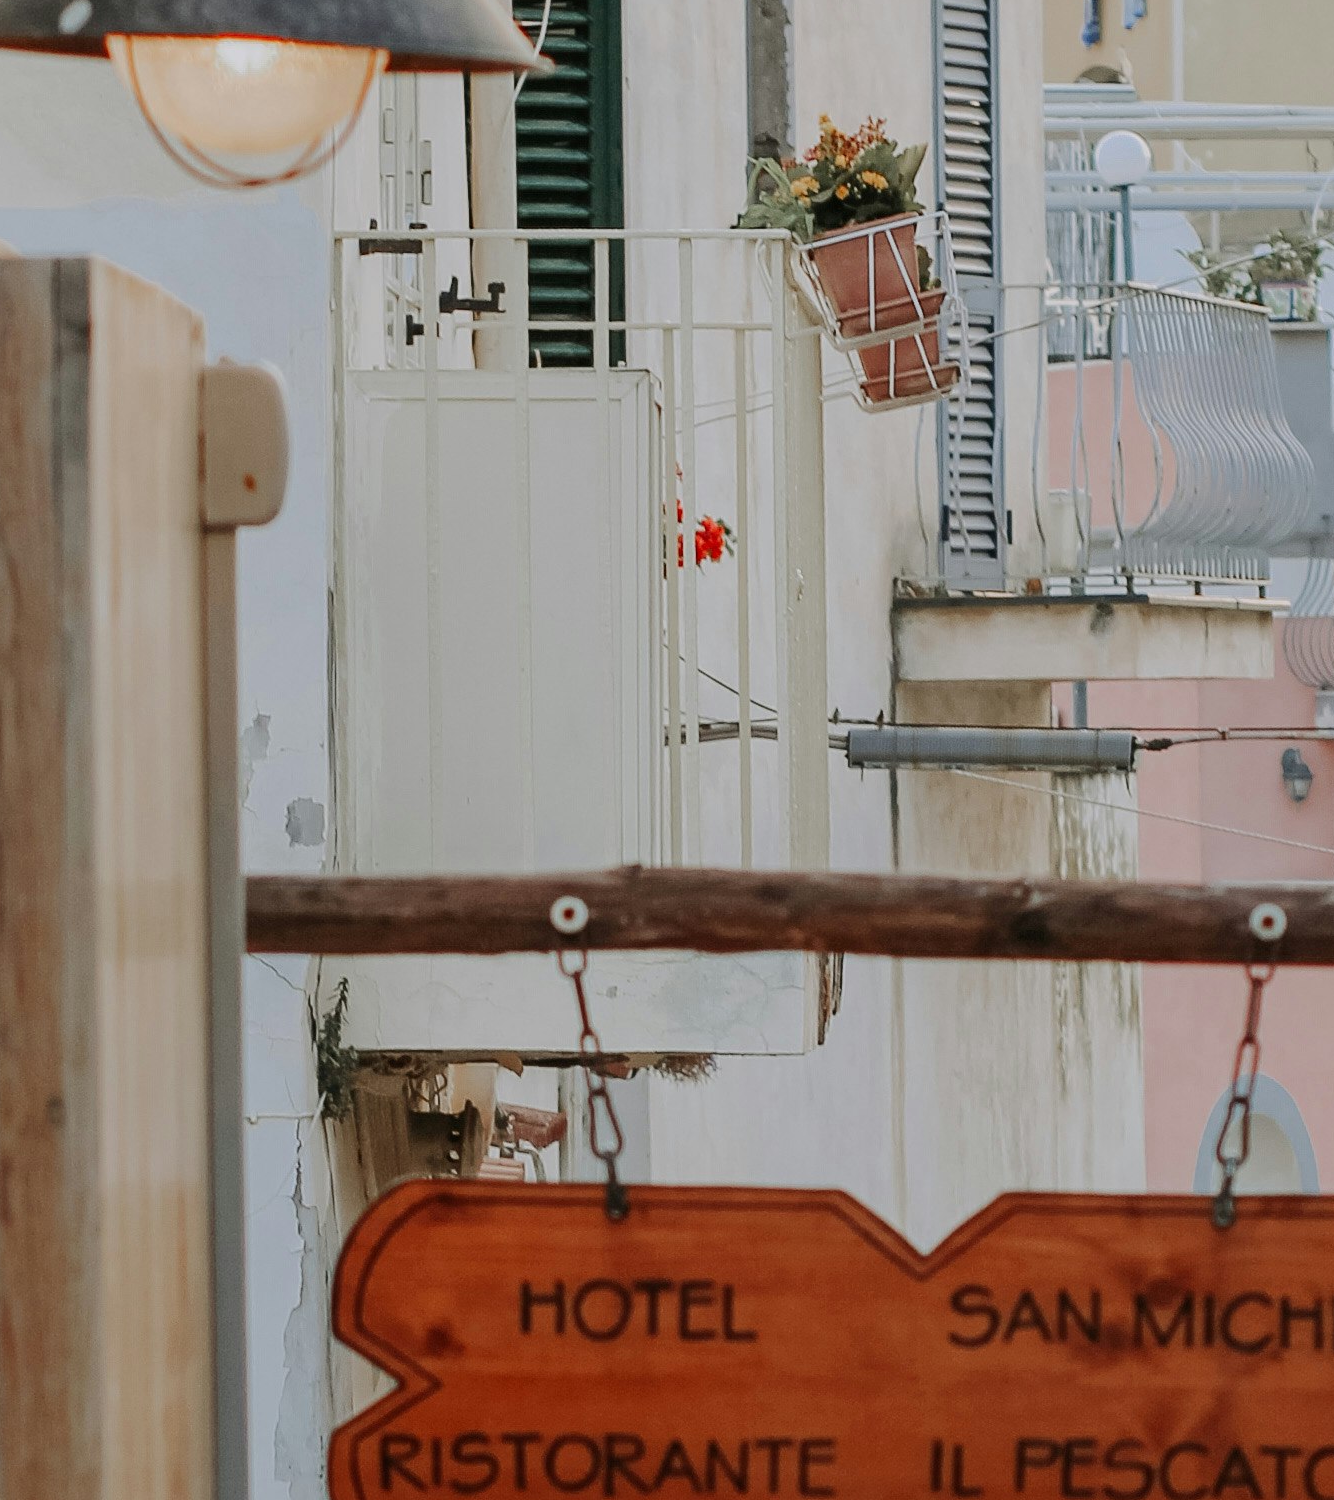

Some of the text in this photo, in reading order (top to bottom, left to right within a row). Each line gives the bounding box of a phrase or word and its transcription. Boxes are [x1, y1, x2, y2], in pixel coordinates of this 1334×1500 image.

[519, 1277, 759, 1343] HOTEL
[947, 1283, 1102, 1348] SAN
[378, 1430, 837, 1498] RISTORANTE
[929, 1436, 985, 1499] IL
